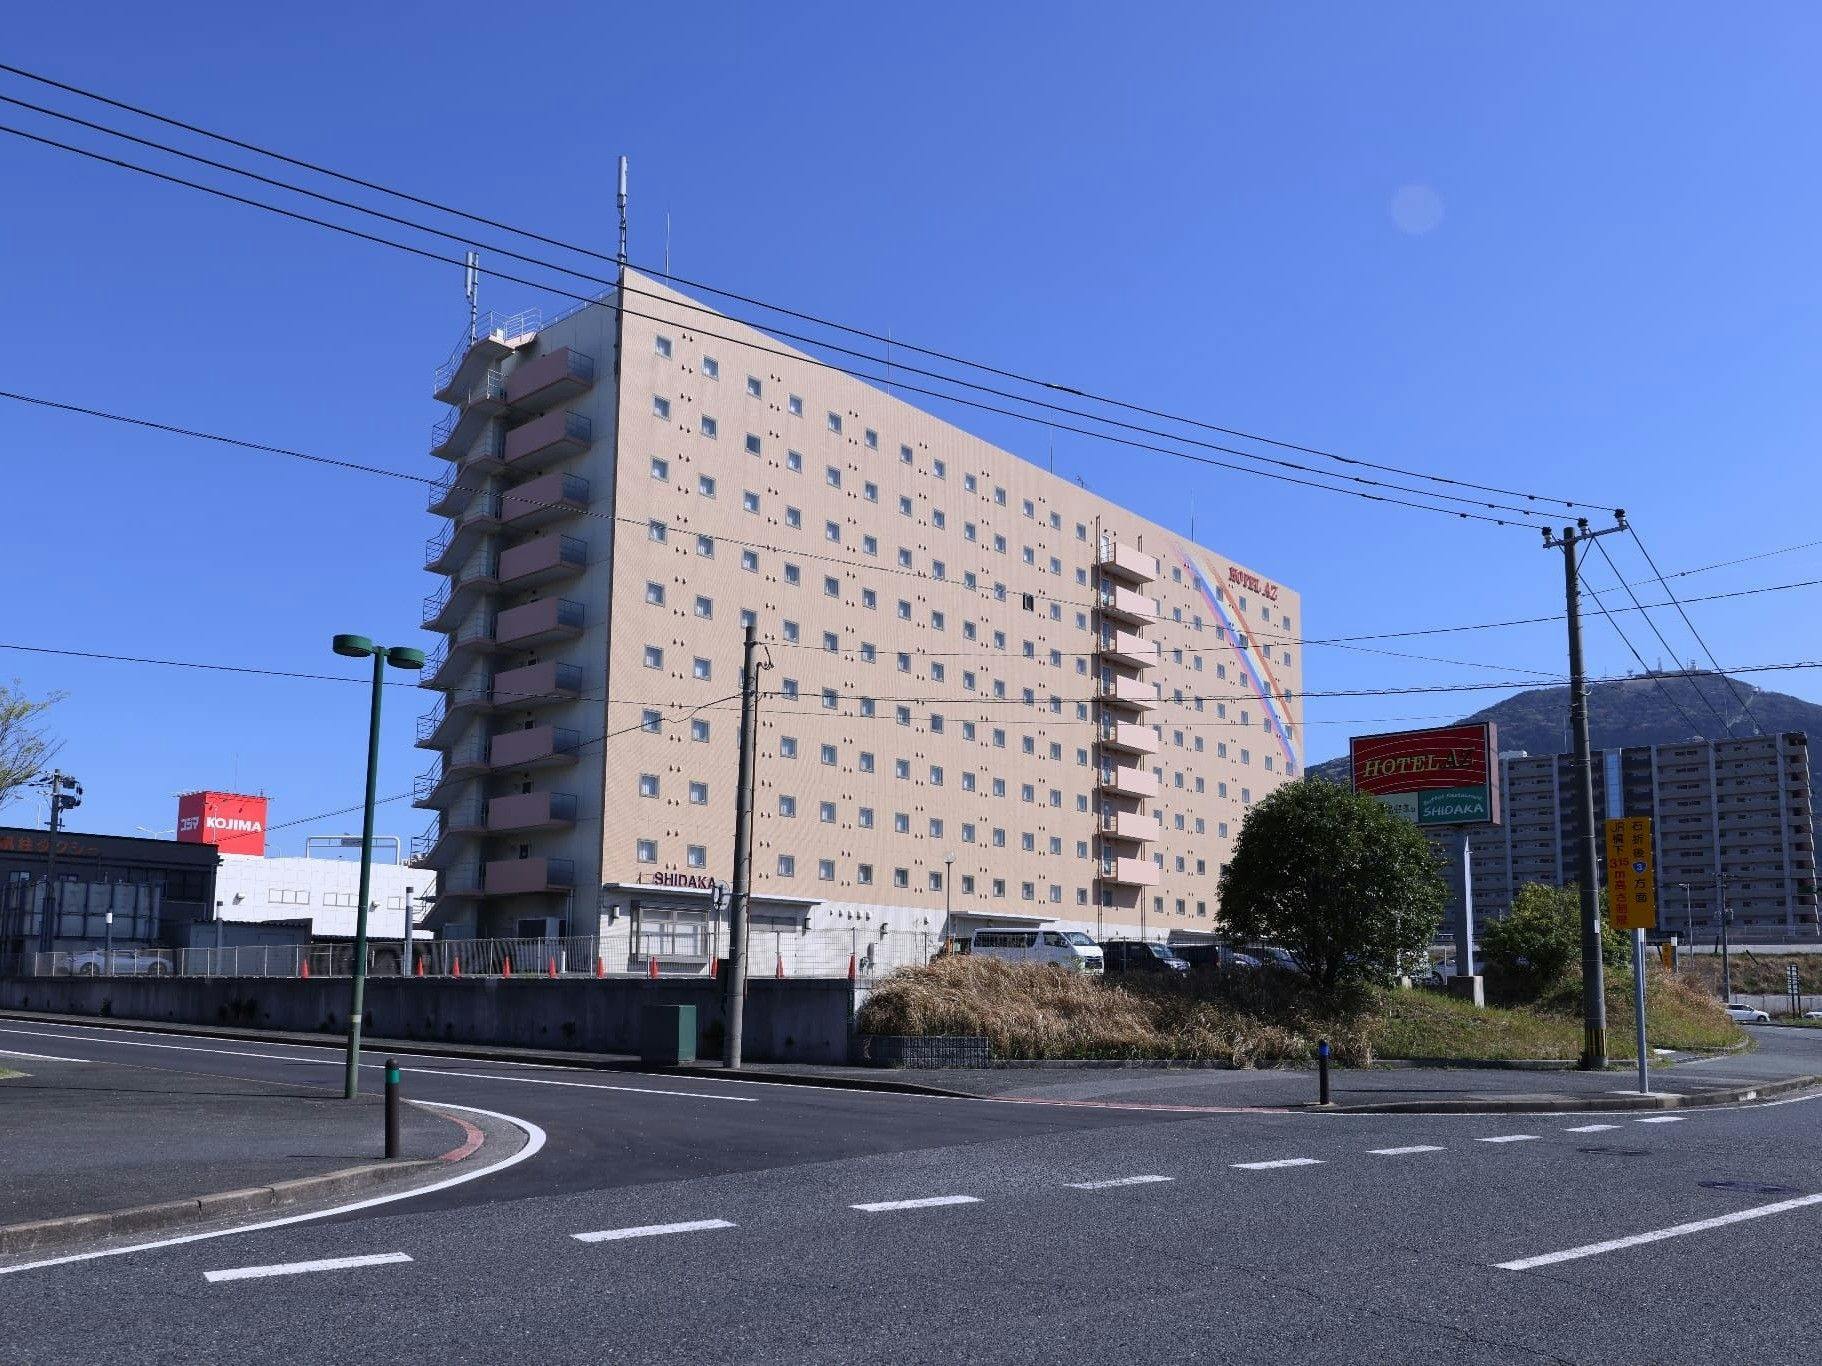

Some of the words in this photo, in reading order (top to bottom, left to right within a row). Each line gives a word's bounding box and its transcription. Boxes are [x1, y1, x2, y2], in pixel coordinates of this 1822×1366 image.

[1228, 567, 1261, 595] HOTEL
[1262, 582, 1279, 601] AZ
[1363, 754, 1440, 778] HOTEL
[1442, 746, 1476, 769] AZ
[1423, 803, 1485, 818] SHIDAKA
[180, 816, 200, 832] コジマ
[206, 816, 263, 833] KOJIMA
[654, 871, 716, 889] SHIDAKA
